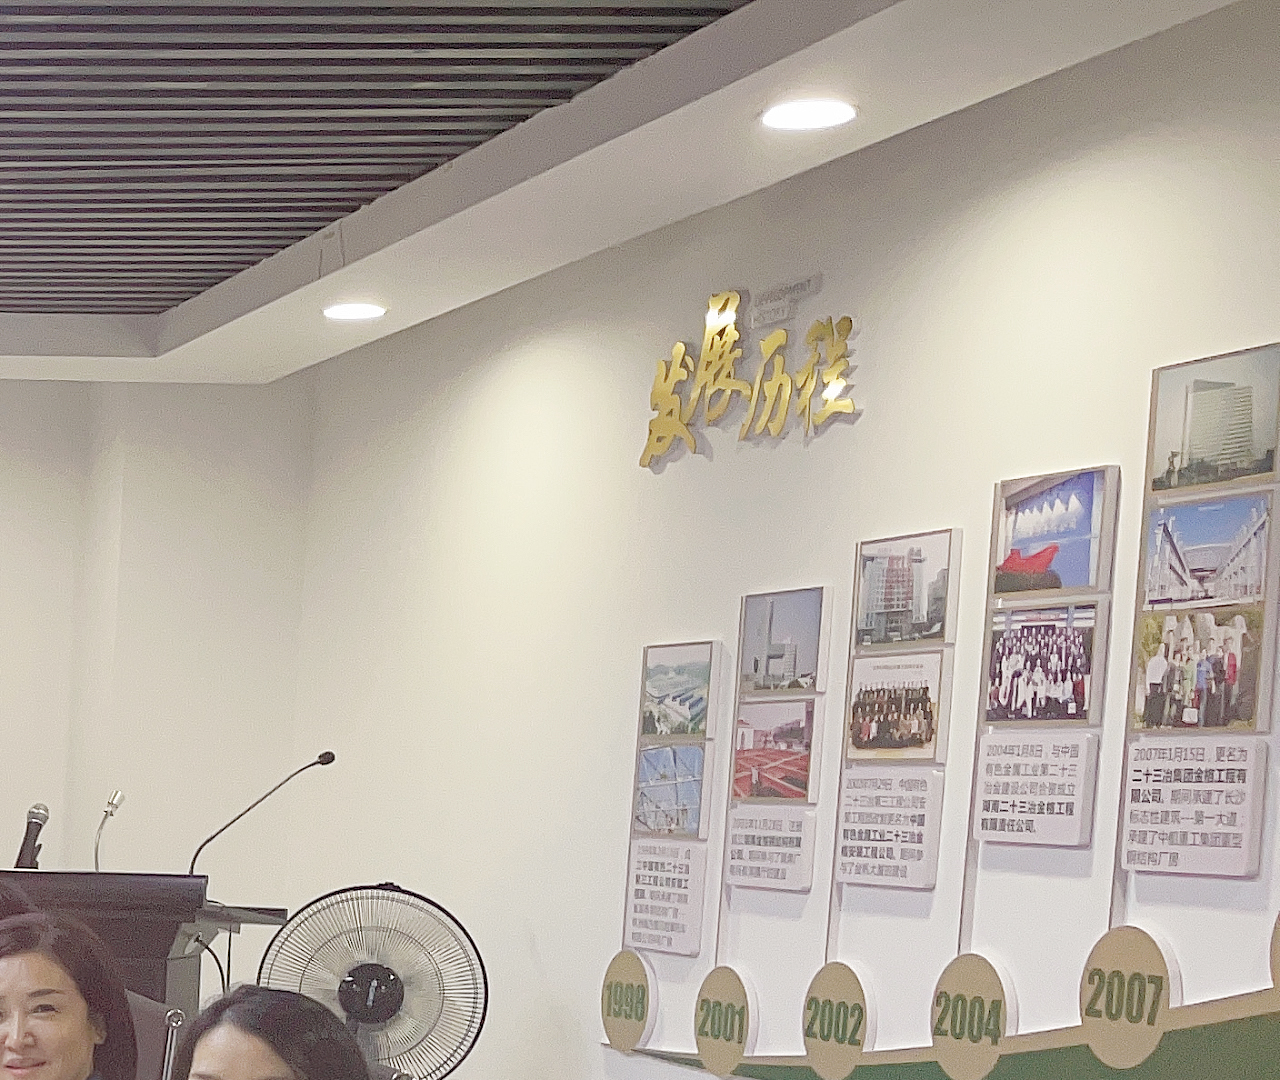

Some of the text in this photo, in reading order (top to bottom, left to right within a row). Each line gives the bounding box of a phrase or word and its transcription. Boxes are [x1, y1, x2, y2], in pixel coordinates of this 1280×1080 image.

[639, 290, 855, 467] 发展历程
[606, 980, 646, 1022] 1998
[698, 998, 745, 1044] 2001
[806, 996, 864, 1046] 2002
[934, 991, 1002, 1046] 2004
[1085, 968, 1163, 1026] 2007
